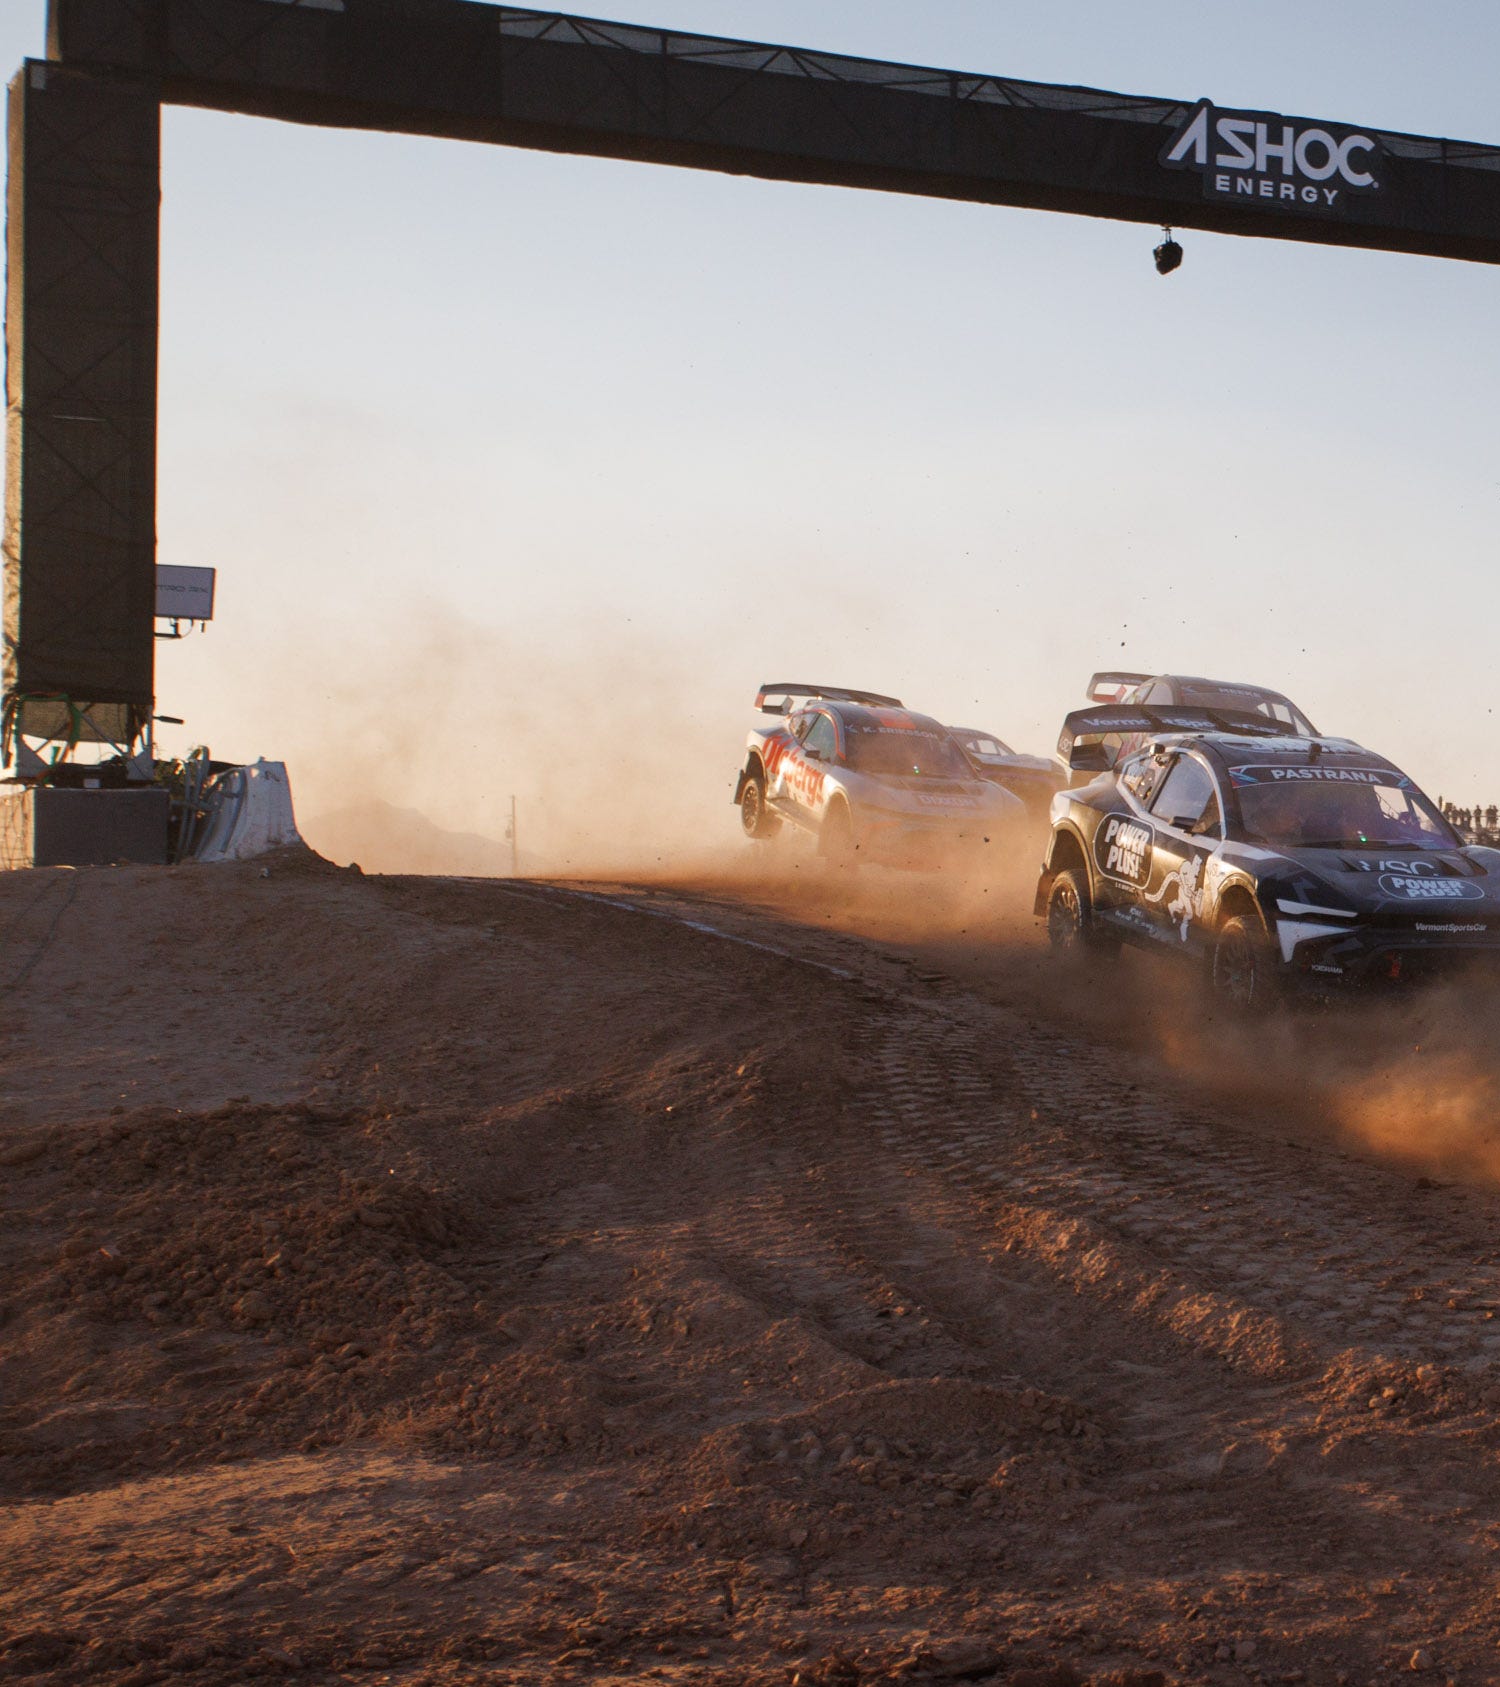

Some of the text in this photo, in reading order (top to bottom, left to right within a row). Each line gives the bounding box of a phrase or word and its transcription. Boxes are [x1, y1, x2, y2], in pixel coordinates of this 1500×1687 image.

[1167, 107, 1377, 187] ASHOC
[1216, 174, 1338, 205] ENERGY
[1271, 769, 1382, 784] PASTRANA
[1104, 819, 1150, 857] POWER
[1106, 845, 1140, 879] PLUS!
[1391, 877, 1465, 889] POWER
[1406, 888, 1463, 898] PLUS!
